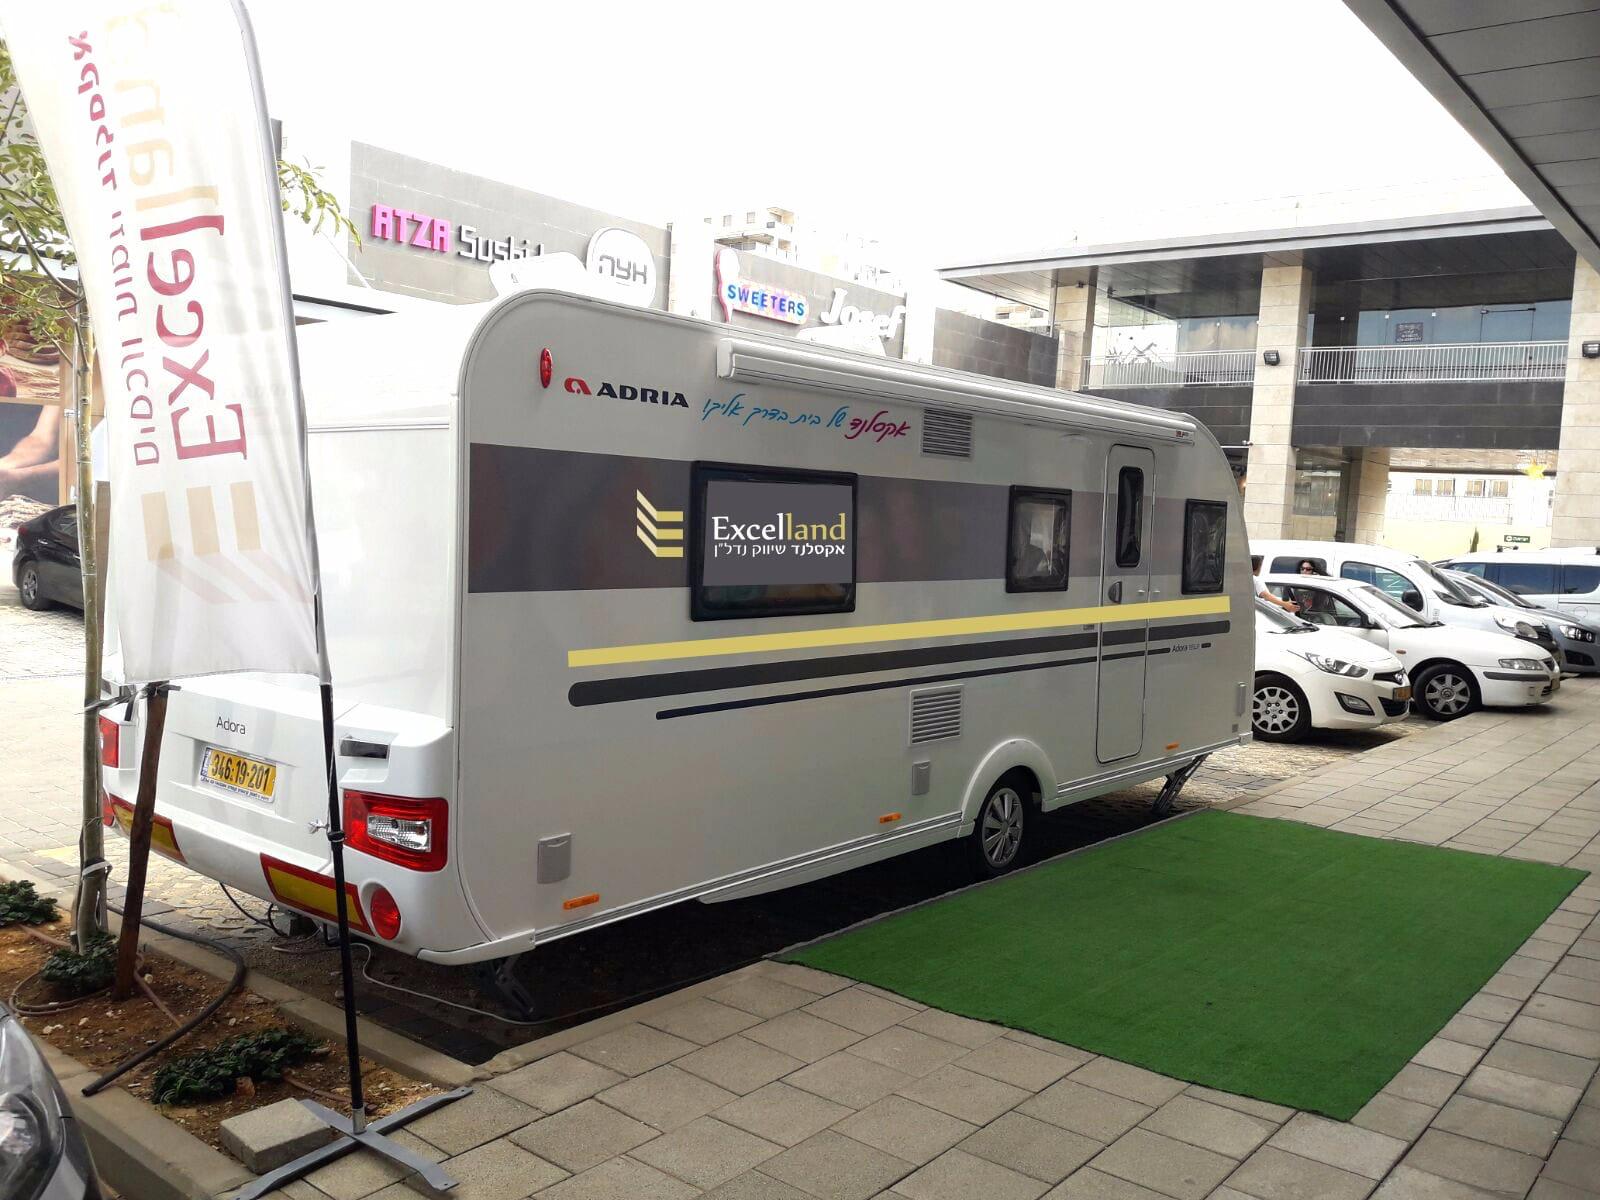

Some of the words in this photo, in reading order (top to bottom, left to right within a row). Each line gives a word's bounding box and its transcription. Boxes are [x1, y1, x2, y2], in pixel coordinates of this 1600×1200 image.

[371, 203, 451, 253] ATZA
[457, 224, 531, 263] Sushi
[727, 284, 805, 317] SWEETERS
[596, 381, 690, 409] ADRIA
[742, 407, 788, 427] בדרך
[789, 413, 821, 425] בית
[826, 405, 850, 428] של
[844, 410, 911, 443] אקסלנד
[711, 512, 846, 541] Excelland
[752, 544, 787, 558] שיווק
[791, 542, 845, 558] אקסלנד
[216, 716, 246, 736] Adora
